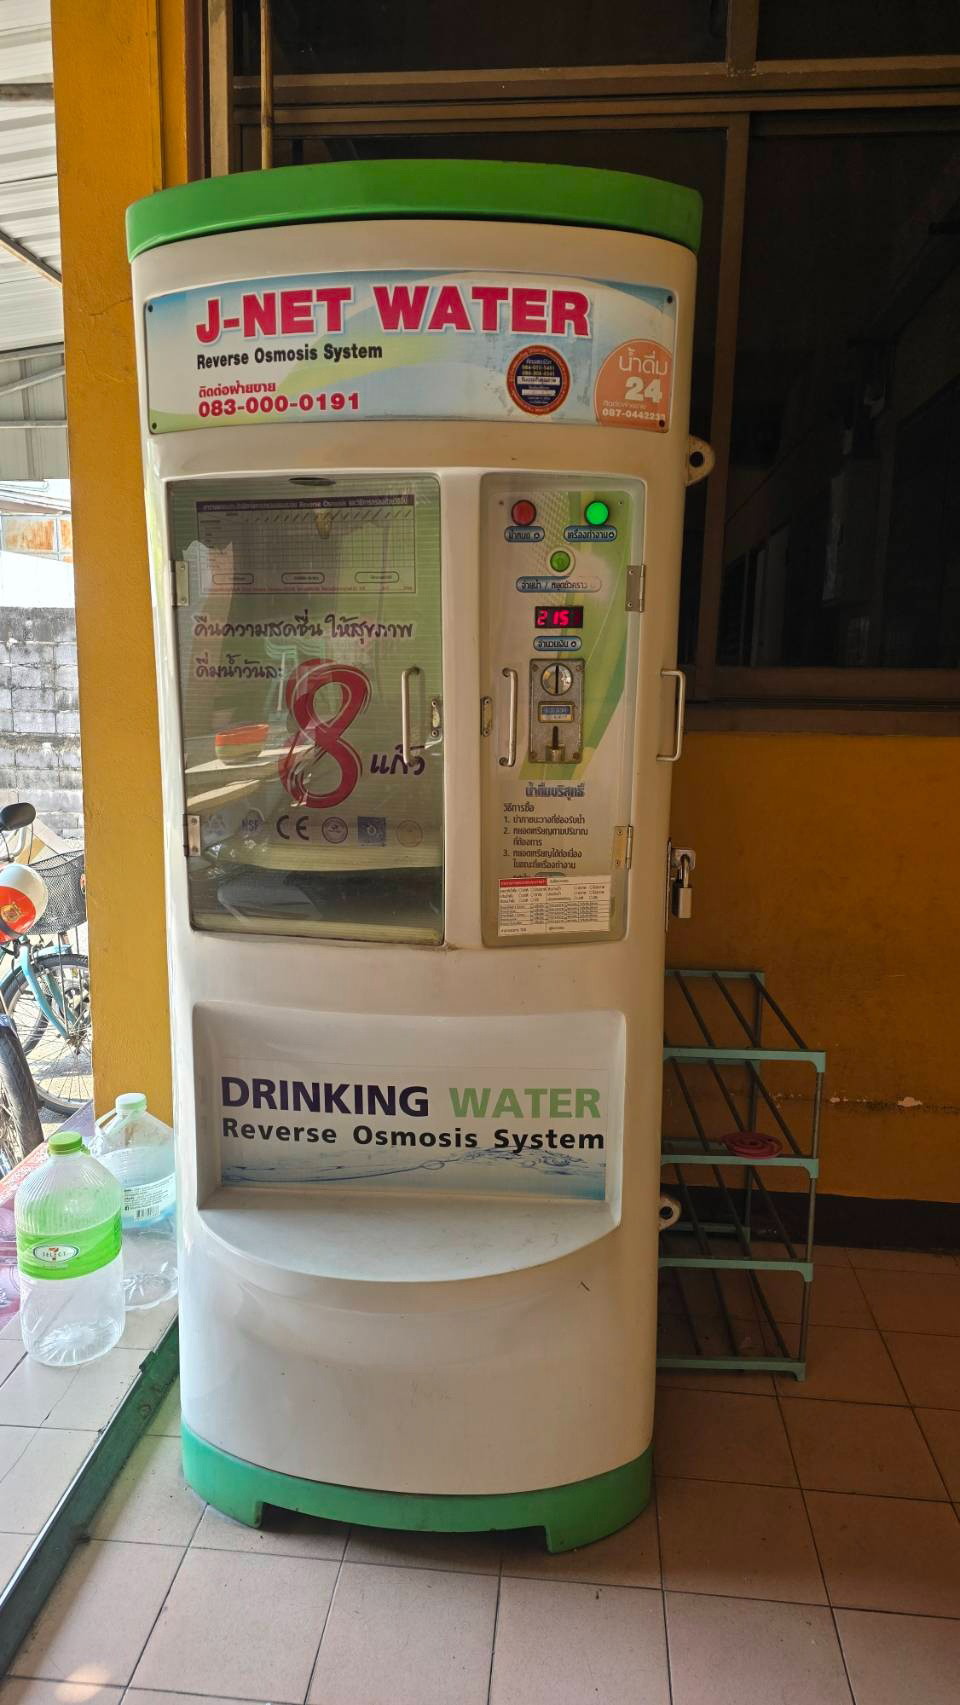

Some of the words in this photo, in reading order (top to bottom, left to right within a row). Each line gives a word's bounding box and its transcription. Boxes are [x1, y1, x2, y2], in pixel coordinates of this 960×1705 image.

[195, 287, 353, 344] J-NET
[372, 285, 590, 337] WATER
[197, 352, 249, 369] Reverse
[254, 344, 318, 363] Osmosis
[323, 343, 383, 362] System
[619, 347, 669, 376] น้ำดื่ม
[198, 380, 276, 398] ติดต่อฝ่ายขาย
[624, 376, 663, 404] 24
[198, 392, 360, 417] 083-000-0191
[193, 609, 323, 638] คืนความสดชื่น
[325, 614, 413, 645] ให้สุขภาพ
[196, 653, 283, 680] ดื่มน้ำวันละ
[278, 658, 372, 809] 8
[276, 815, 310, 840] CE
[221, 1076, 429, 1117] DRINKING
[448, 1087, 601, 1119] WATER
[222, 1117, 337, 1143] Reverse
[353, 1125, 478, 1148] Osmosis
[494, 1128, 604, 1154] System
